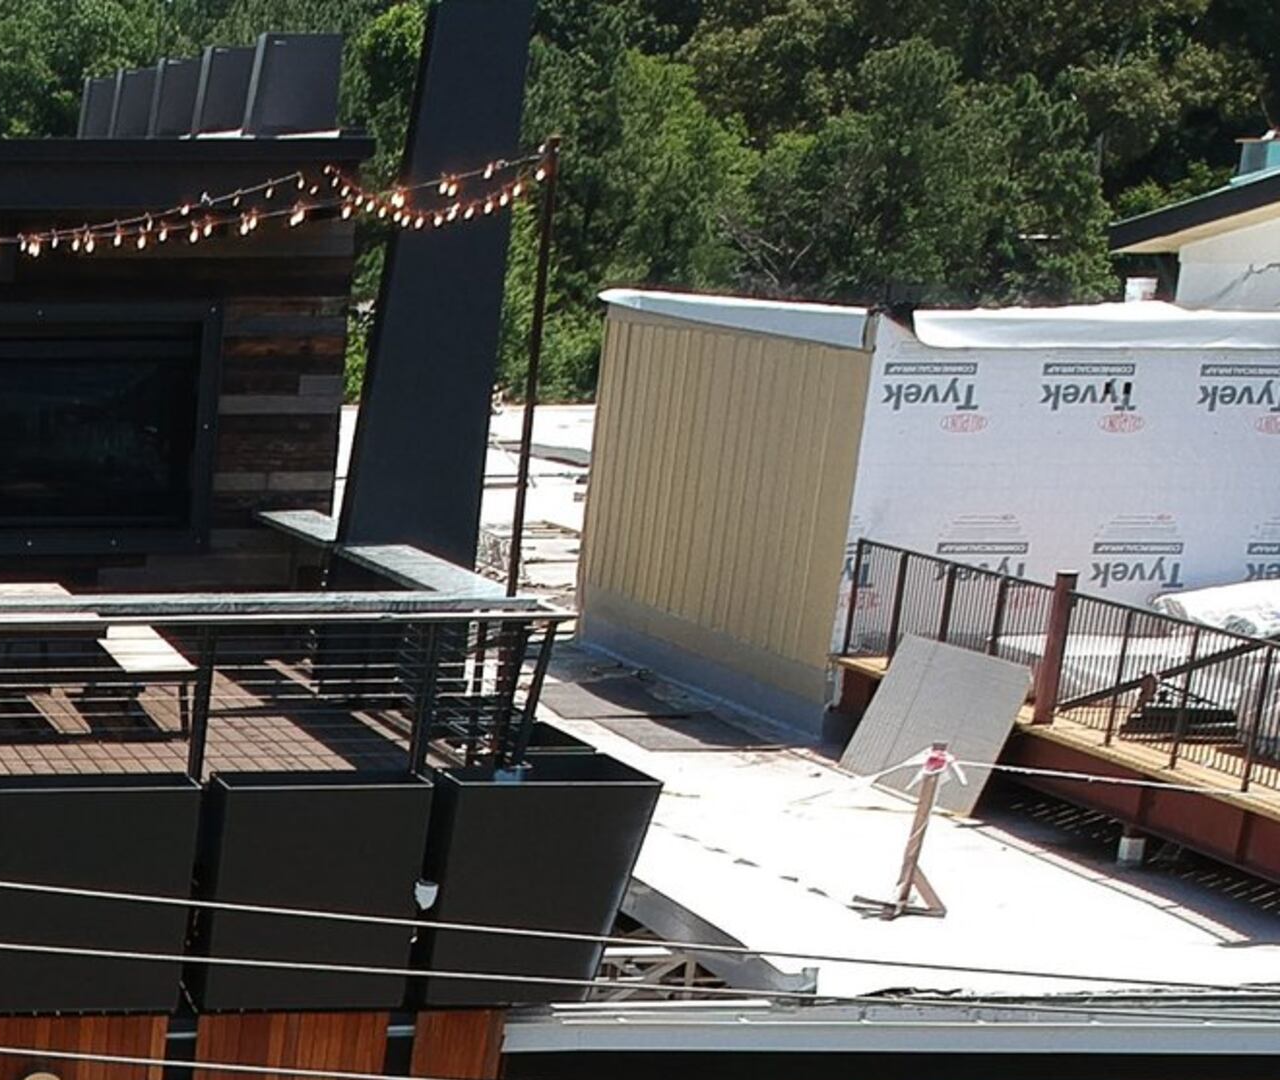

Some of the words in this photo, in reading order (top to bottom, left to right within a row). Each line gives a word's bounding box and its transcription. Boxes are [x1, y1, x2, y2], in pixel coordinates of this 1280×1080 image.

[882, 377, 980, 411] Tyvek
[1040, 378, 1137, 411] Tyvek
[1090, 556, 1185, 588] Tyvek
